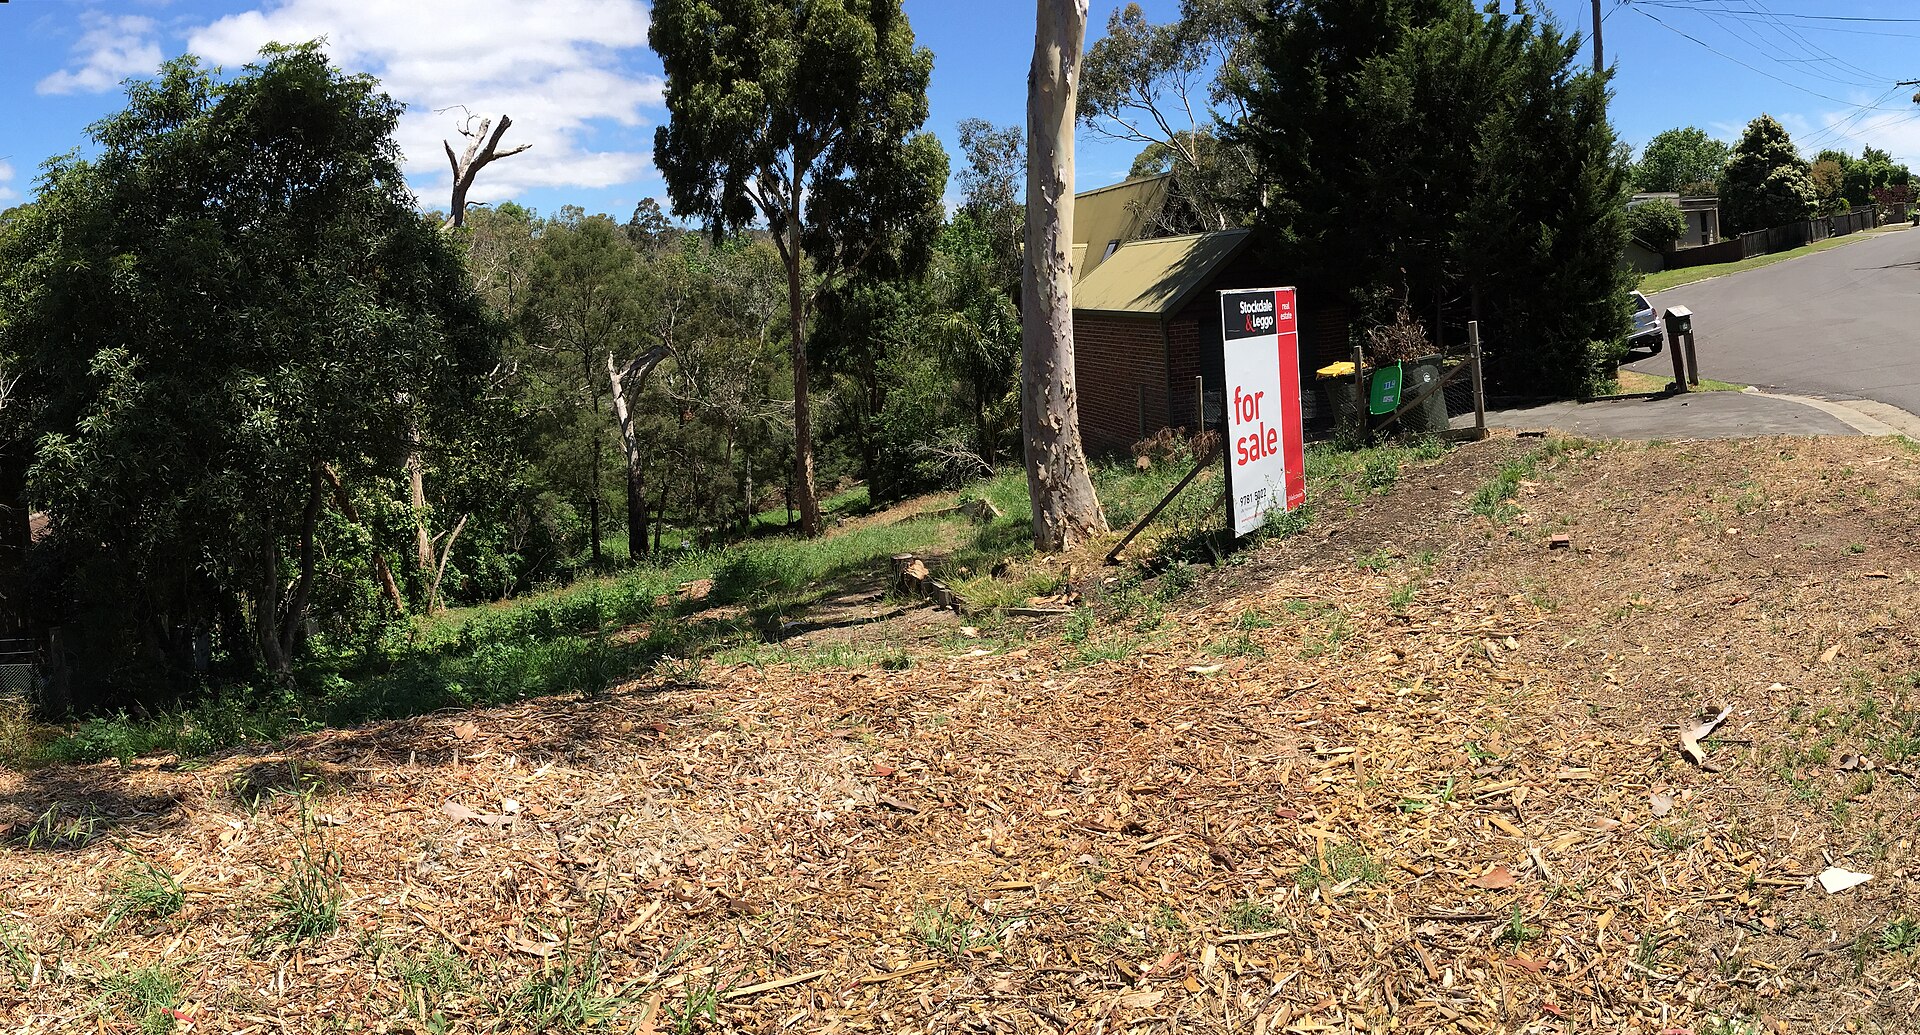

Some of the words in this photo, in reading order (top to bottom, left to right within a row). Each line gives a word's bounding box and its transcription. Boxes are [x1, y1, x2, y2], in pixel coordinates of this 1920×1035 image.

[1240, 299, 1273, 314] Stockdale
[1281, 301, 1290, 310] real
[1252, 314, 1273, 330] Leggo
[1280, 312, 1292, 320] estate
[1234, 385, 1264, 425] for
[1237, 421, 1277, 466] sale
[1240, 493, 1253, 507] 9781
[1254, 487, 1267, 501] 5022
